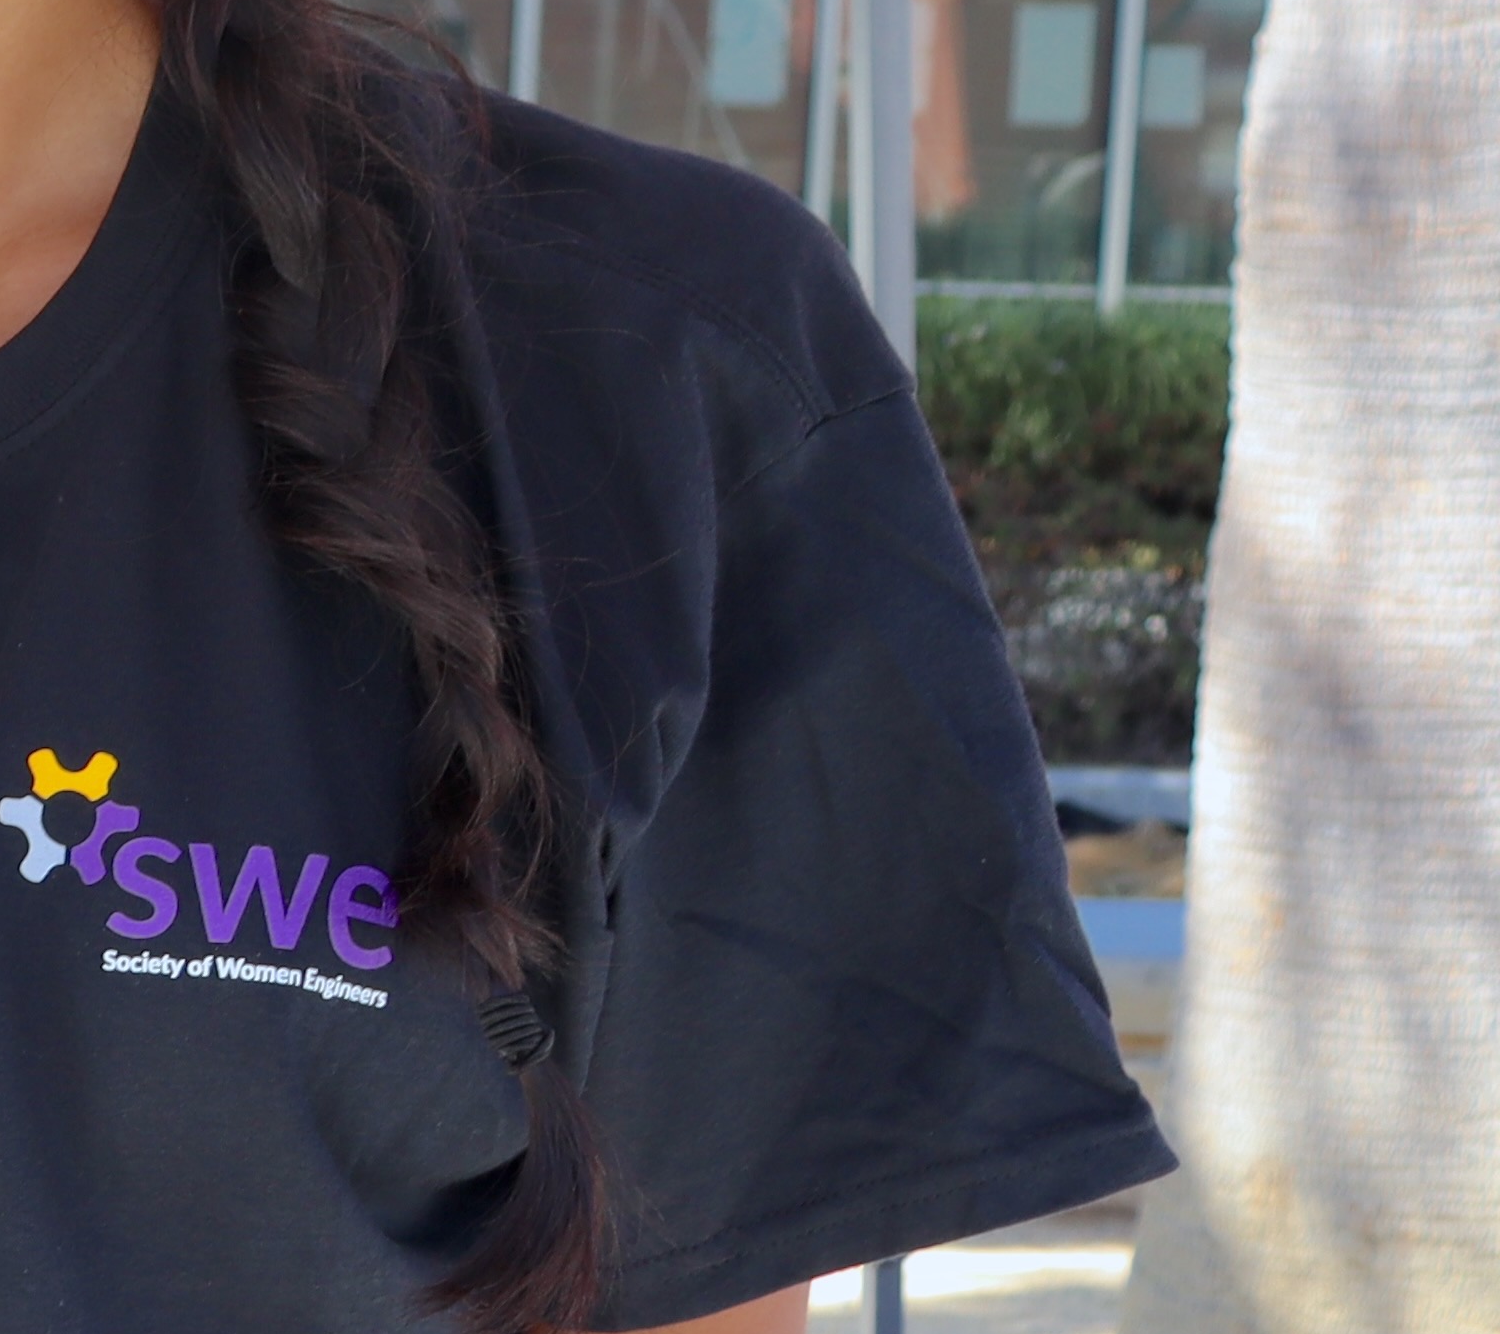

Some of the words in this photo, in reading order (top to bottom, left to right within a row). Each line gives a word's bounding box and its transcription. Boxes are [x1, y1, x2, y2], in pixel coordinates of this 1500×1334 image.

[106, 836, 398, 970] swe
[101, 949, 186, 979] Society
[187, 955, 214, 977] of
[215, 956, 301, 987] Women
[303, 968, 389, 1009] Engineers
